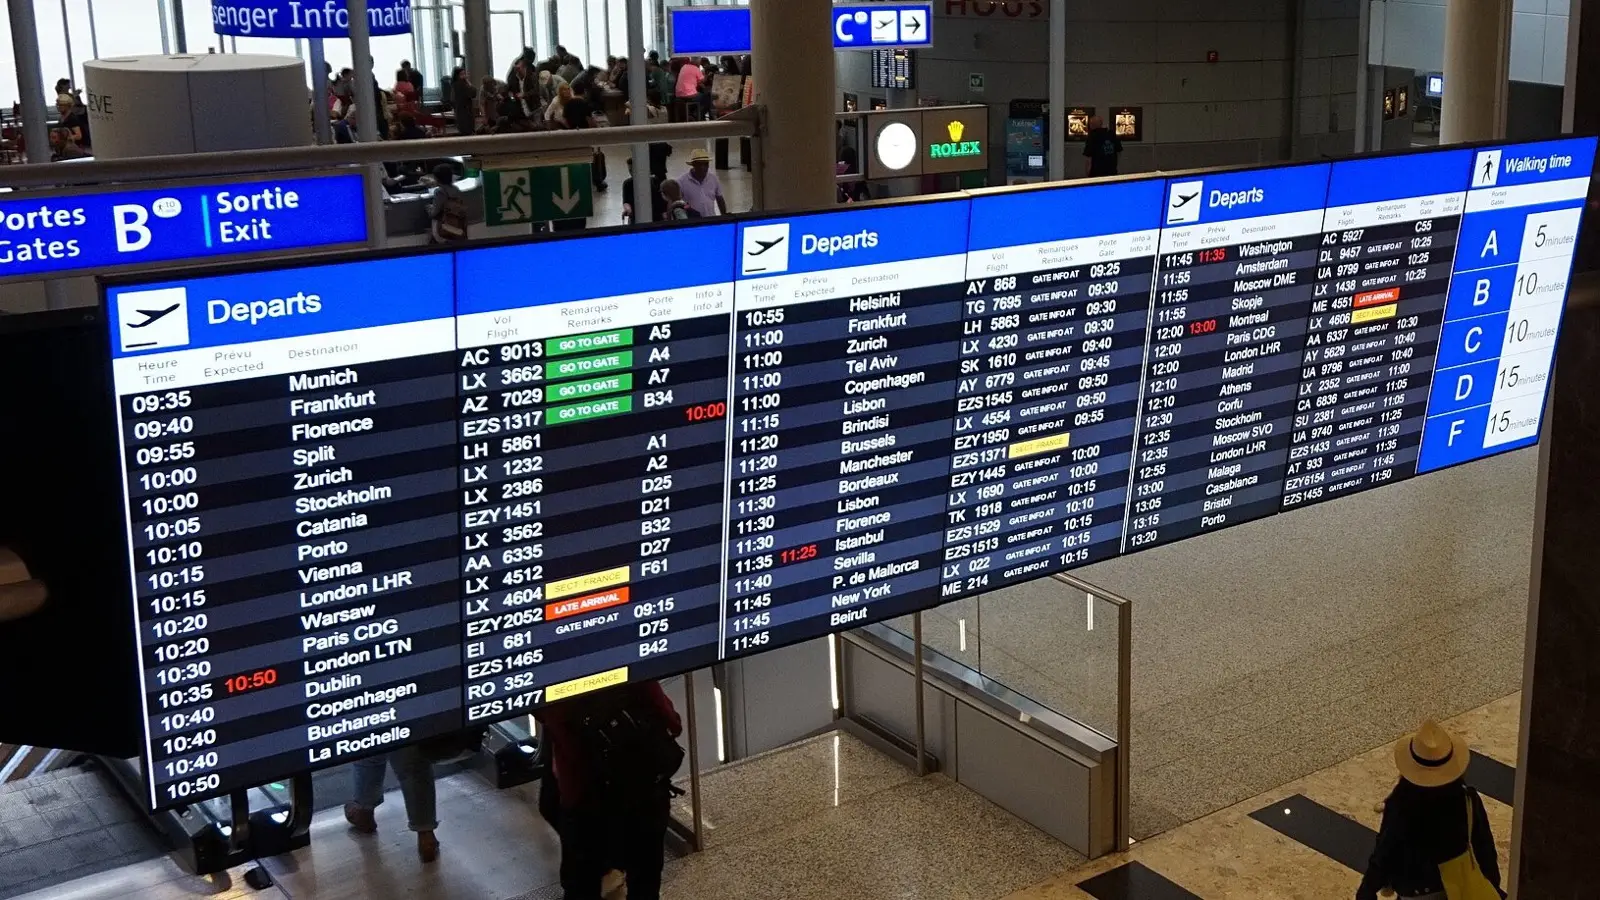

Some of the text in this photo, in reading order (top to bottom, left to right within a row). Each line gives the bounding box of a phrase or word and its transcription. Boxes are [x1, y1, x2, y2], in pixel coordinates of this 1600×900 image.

[930, 141, 981, 157] ROLEX
[1505, 154, 1572, 173] Walking time
[216, 186, 299, 214] Sortie
[1208, 187, 1264, 209] Departs
[113, 204, 152, 252] B
[219, 218, 273, 243] Exit
[801, 229, 879, 256] Departs
[1239, 241, 1292, 257] Washington
[1480, 229, 1499, 258] A
[1166, 253, 1193, 267] 11:45
[1320, 246, 1361, 262] DL 9457
[1090, 262, 1120, 278] 09:25
[1236, 258, 1288, 275] Amsterdam
[647, 294, 674, 305] Porte
[850, 292, 900, 312] Helsinki
[1472, 278, 1491, 306] B
[207, 292, 322, 325] Departs
[560, 302, 619, 317] Remarques
[649, 307, 672, 318] Gate
[966, 295, 1021, 314] TG 7695
[493, 315, 512, 325] Vol
[567, 315, 612, 328] Remarks
[746, 308, 784, 326] 10:55
[849, 313, 906, 333] Frankfurt
[1229, 310, 1269, 327] Montreal
[487, 326, 518, 340] Flight
[560, 334, 619, 349] GO TO GATE
[649, 324, 671, 340] A5
[1464, 326, 1483, 353] C
[214, 350, 252, 361] Prévu
[288, 343, 359, 359] Destination
[462, 342, 542, 366] AC 9013
[138, 359, 178, 371] Heure
[204, 361, 264, 377] Expected
[846, 355, 897, 374] Tel Aviv
[961, 353, 1016, 373] SK 1610
[1080, 355, 1110, 371] 09:45
[144, 374, 176, 385] Time
[290, 368, 357, 391] Munich
[845, 372, 925, 394] Copenhagen
[1219, 382, 1252, 396] Athens
[1455, 374, 1473, 401] D
[133, 391, 191, 413] 09:35
[291, 390, 375, 416] Frankfurt
[644, 390, 673, 407] B34
[1218, 398, 1243, 413] Corfu
[685, 402, 726, 421] 10:00
[1146, 413, 1172, 428] 12:30
[292, 418, 373, 441] Florence
[741, 414, 779, 432] 11:15
[843, 414, 889, 434] Brindisi
[1448, 419, 1465, 447] F
[137, 442, 195, 465] 09:55
[293, 446, 335, 467] Split
[464, 434, 540, 460] LH 5861
[840, 451, 913, 474] Manchester
[294, 467, 352, 490] Zurich
[739, 475, 776, 493] 11:25
[839, 473, 898, 494] Bordeaux
[1206, 475, 1258, 495] Casablanca
[296, 486, 391, 513] Stockholm
[465, 478, 543, 505] LX 2386
[143, 492, 198, 515] 10:00
[642, 497, 669, 514] D21
[948, 501, 1002, 523] TK 1918
[1066, 497, 1094, 513] 10:10
[1203, 495, 1232, 511] Bristol
[297, 513, 367, 537] Catania
[836, 529, 884, 551] Istanbul
[1131, 530, 1157, 546] 13:20
[147, 542, 202, 565] 10:10
[298, 541, 348, 561] Porto
[465, 544, 543, 572] AA 6335
[780, 544, 816, 561] 11:25
[298, 562, 362, 583] Vienna
[642, 558, 667, 576] F61
[736, 555, 773, 573] 11:35
[301, 571, 412, 607] London LHR
[735, 574, 772, 593] 11:40
[151, 590, 206, 613] 10:15
[555, 594, 619, 614] LATE ARRIVAL
[832, 583, 891, 608] New York
[301, 605, 375, 630] Warsaw
[634, 597, 674, 618] 09:15
[831, 607, 867, 626] Beirut
[556, 612, 619, 634] GATE INFO AT
[303, 619, 398, 653] Paris CDG
[155, 638, 209, 661] 10:20
[304, 637, 411, 675] London LTN
[225, 668, 277, 693] 10:50
[305, 674, 361, 697] Dublin
[468, 672, 533, 700] RO 352
[159, 683, 213, 708] 10:35
[307, 683, 416, 718] Copenhagen
[308, 707, 396, 741] Bucharest
[164, 729, 216, 754] 10:40
[309, 726, 410, 762] La Rochelle
[168, 774, 219, 798] 10:50
